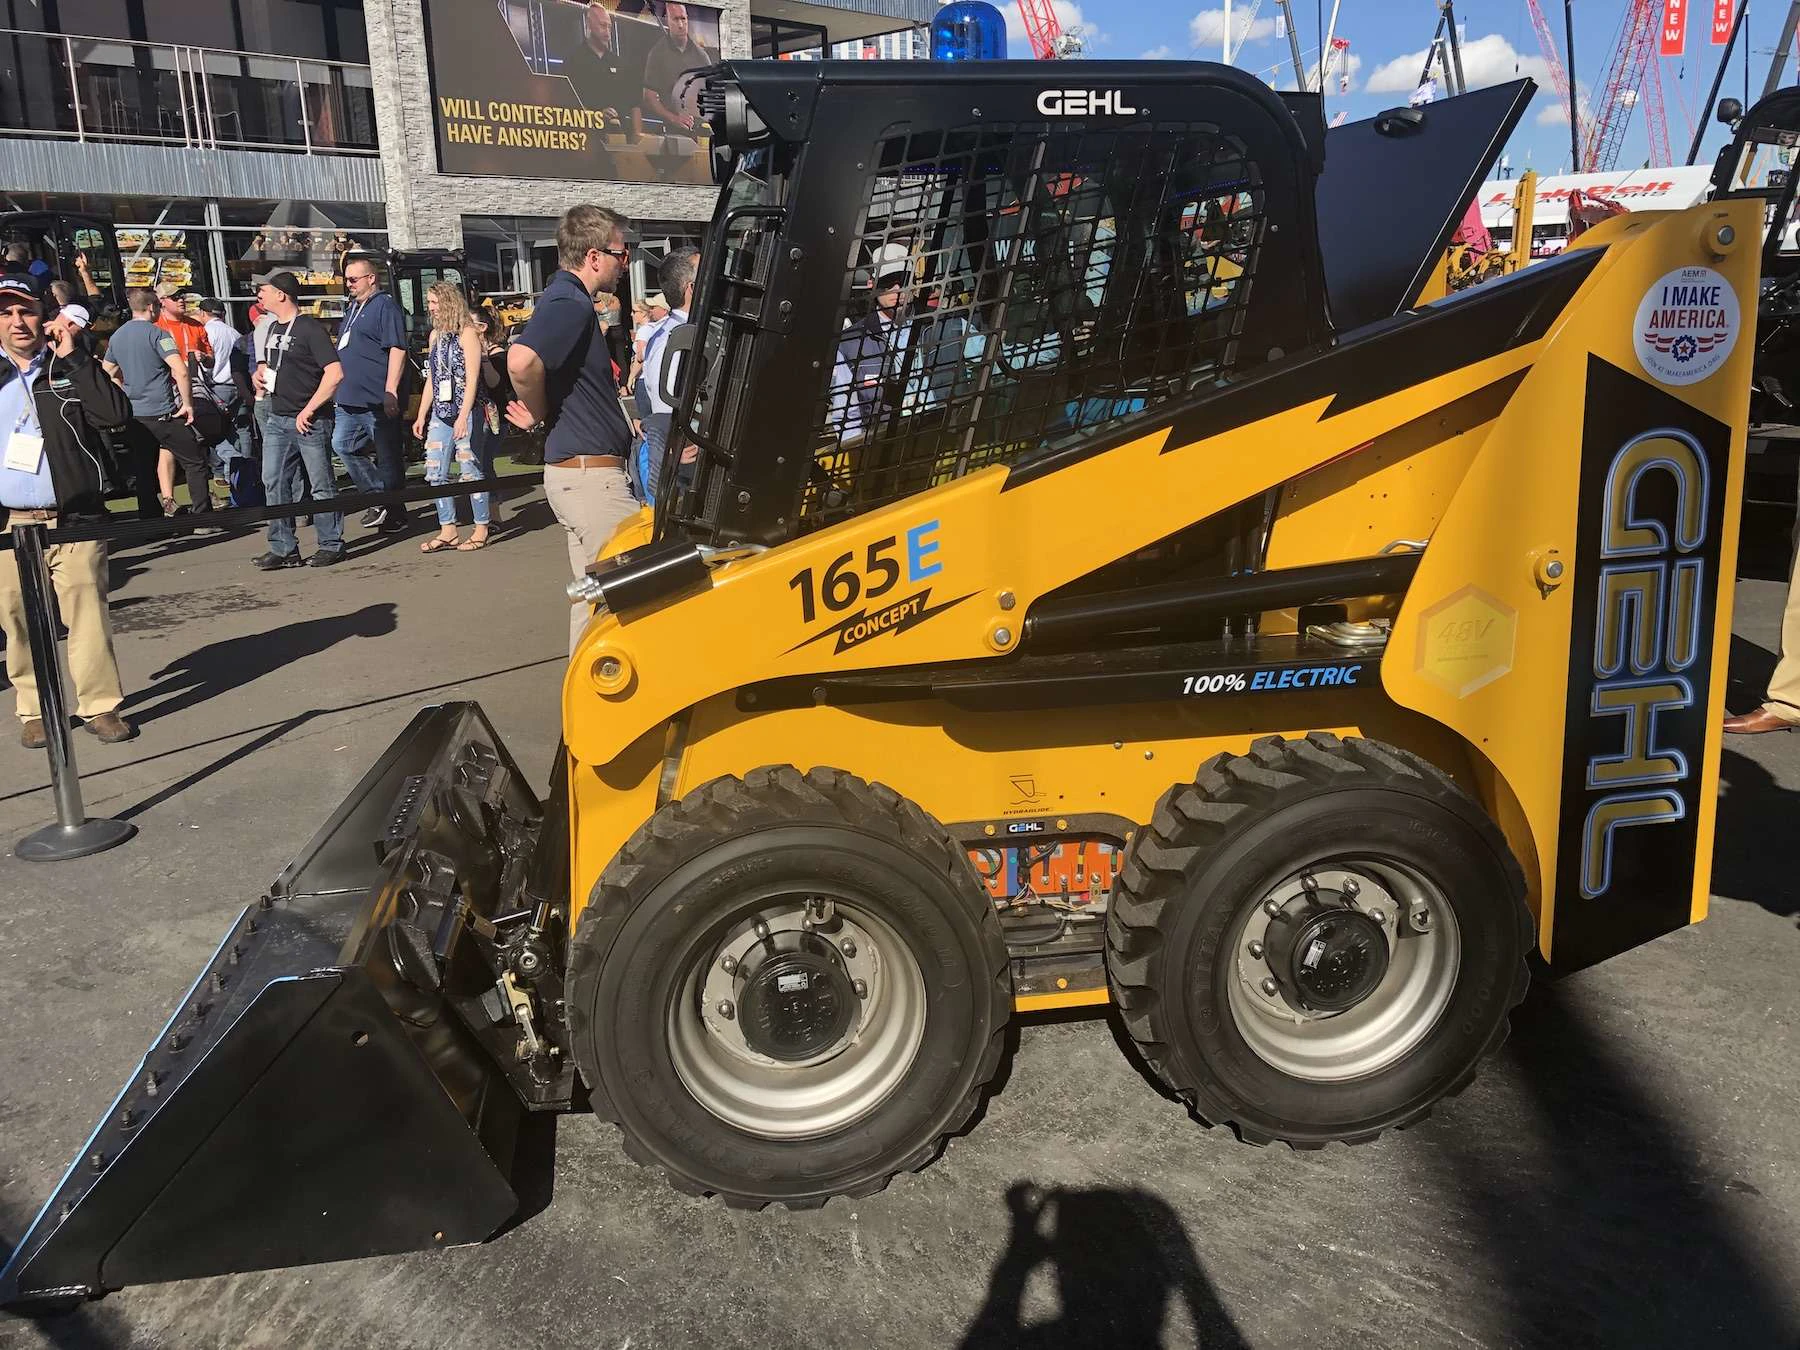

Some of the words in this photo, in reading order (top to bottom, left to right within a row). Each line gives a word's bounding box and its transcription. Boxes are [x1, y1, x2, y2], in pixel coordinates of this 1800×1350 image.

[1665, 0, 1680, 41] NEW
[439, 97, 486, 121] WILL
[488, 101, 606, 130] CONTESTANTS
[1036, 89, 1137, 116] GEHL
[446, 122, 494, 145] HAVE
[497, 127, 588, 151] ANSWERS?
[1662, 286, 1669, 306] I
[1671, 286, 1721, 306] MAKE
[1648, 309, 1725, 329] AMERICA
[788, 519, 944, 624] 165E
[843, 598, 921, 645] CONCEPT
[1579, 426, 1711, 900] GEHL
[1183, 672, 1247, 695] 100%
[1250, 665, 1362, 691] ELECTRIC
[1009, 822, 1044, 833] GEHL
